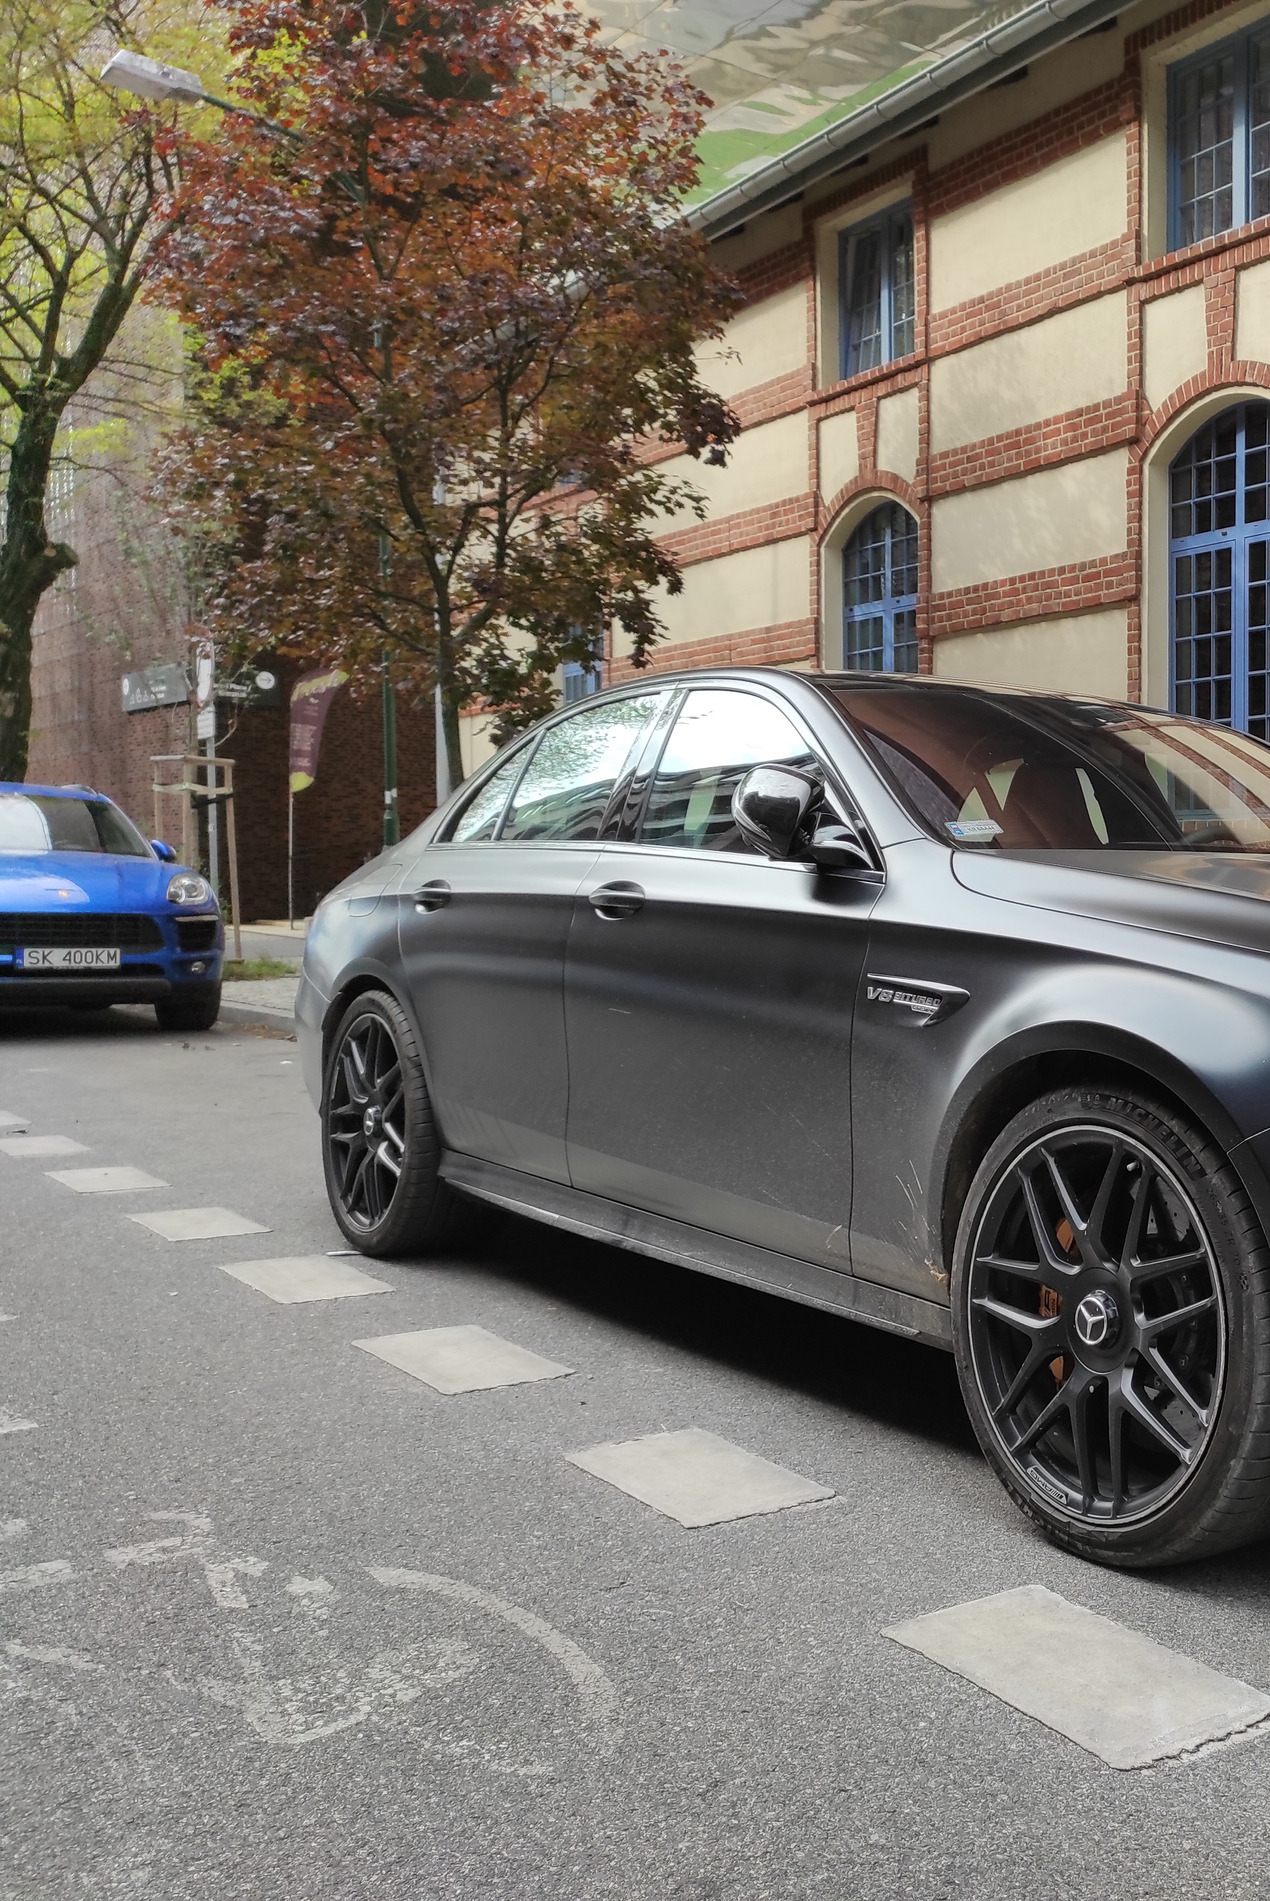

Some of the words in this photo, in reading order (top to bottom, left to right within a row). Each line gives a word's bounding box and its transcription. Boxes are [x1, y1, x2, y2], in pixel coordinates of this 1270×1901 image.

[28, 950, 54, 965] SK
[62, 950, 117, 965] 400KM
[894, 992, 941, 1006] BITURBO
[1106, 1096, 1201, 1174] MICHELIN
